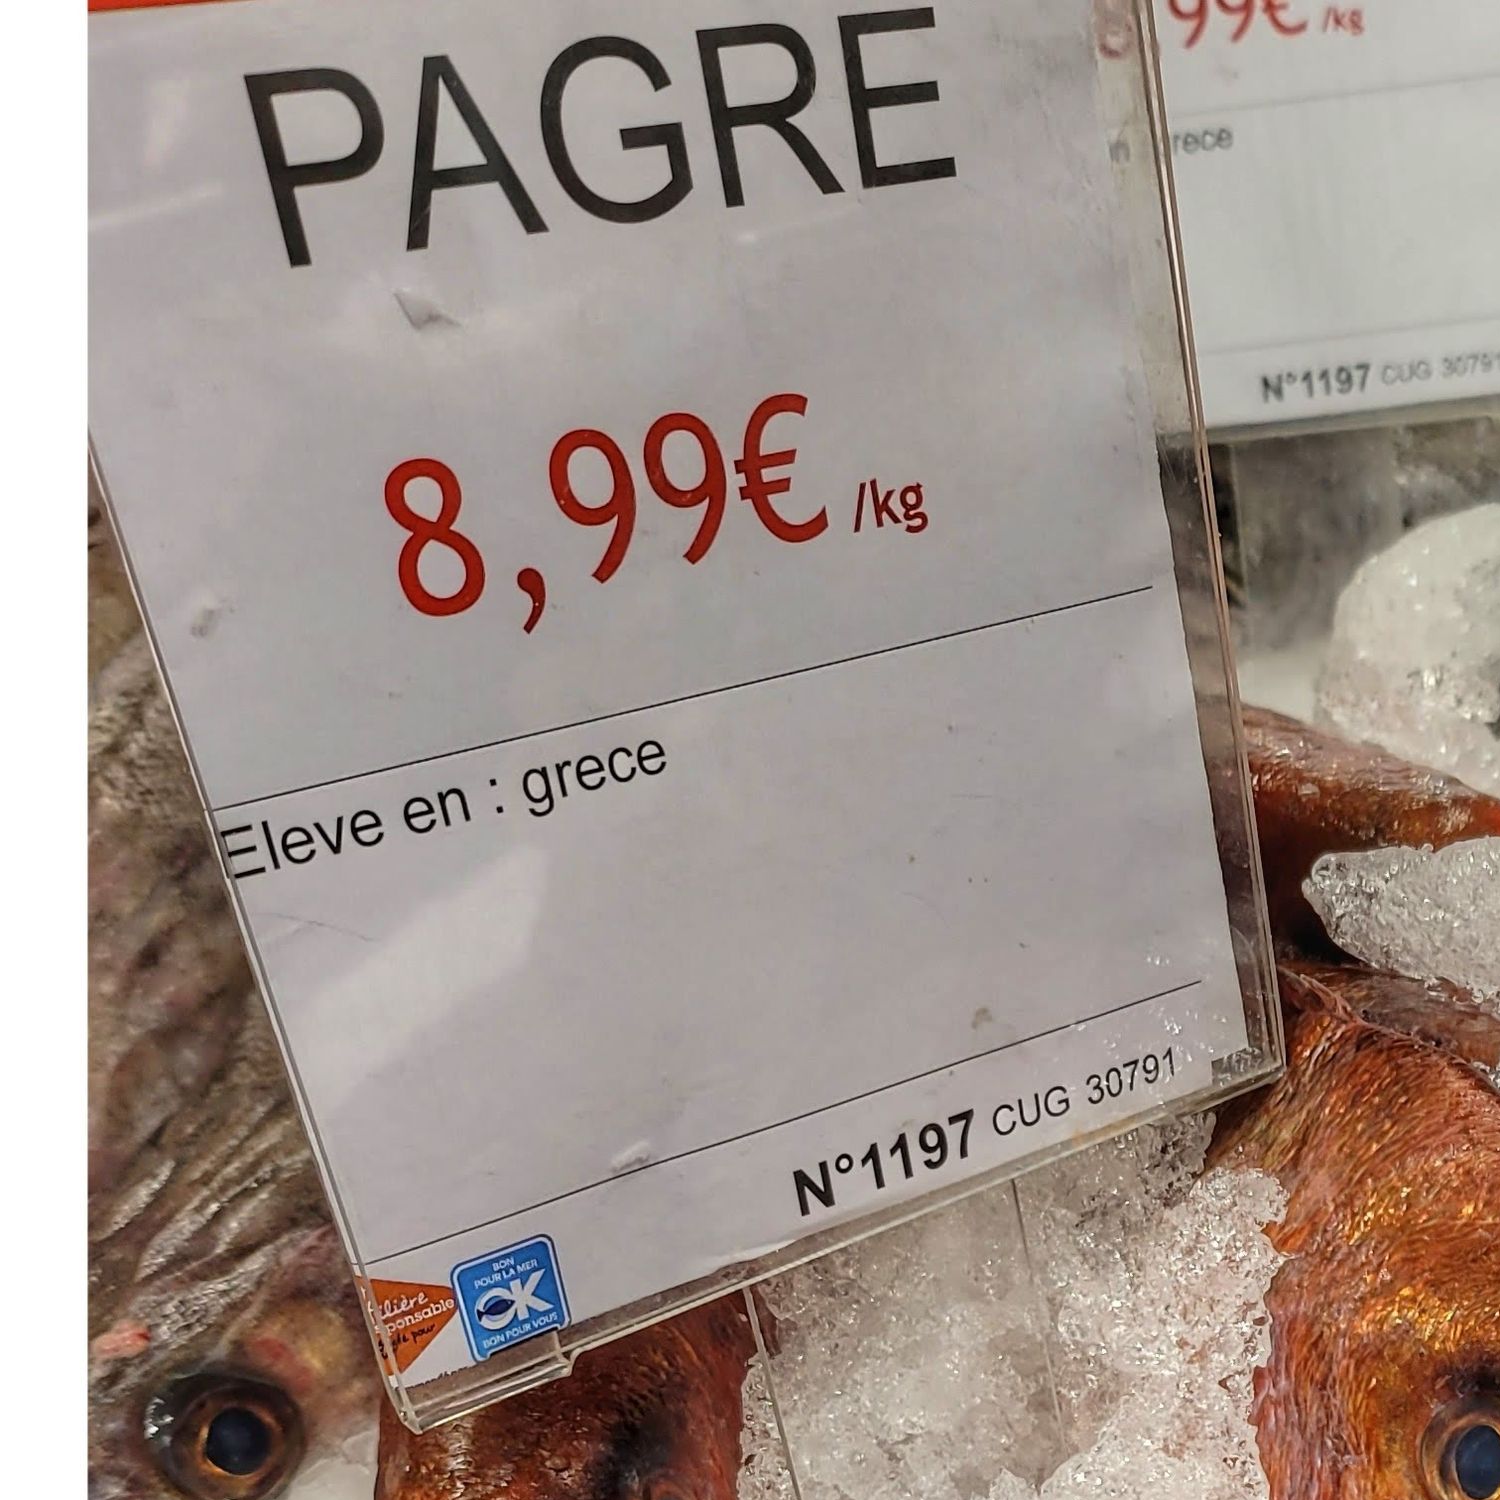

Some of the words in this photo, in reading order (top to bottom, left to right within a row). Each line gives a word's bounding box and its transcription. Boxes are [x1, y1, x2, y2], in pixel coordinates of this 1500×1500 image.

[243, 7, 957, 268] PAGRE
[1172, 127, 1233, 155] rece
[1261, 362, 1371, 404] N°1197
[1381, 359, 1432, 386] CUG
[384, 394, 829, 634] 8,99€
[853, 478, 929, 533] /kg
[220, 808, 385, 880] Eleve
[402, 786, 471, 835] en
[489, 777, 505, 814] :
[522, 738, 667, 817] grece
[793, 1108, 975, 1217] N°1197
[991, 1085, 1072, 1137] CUG
[1085, 1046, 1177, 1105] 30791
[474, 1272, 502, 1289] POUR
[502, 1268, 516, 1279] LA
[517, 1258, 539, 1274] MER
[492, 1256, 515, 1272] BON
[474, 1268, 555, 1331] OK
[483, 1333, 506, 1349] BON
[505, 1322, 532, 1338] POUR
[532, 1311, 558, 1329] VOUS
